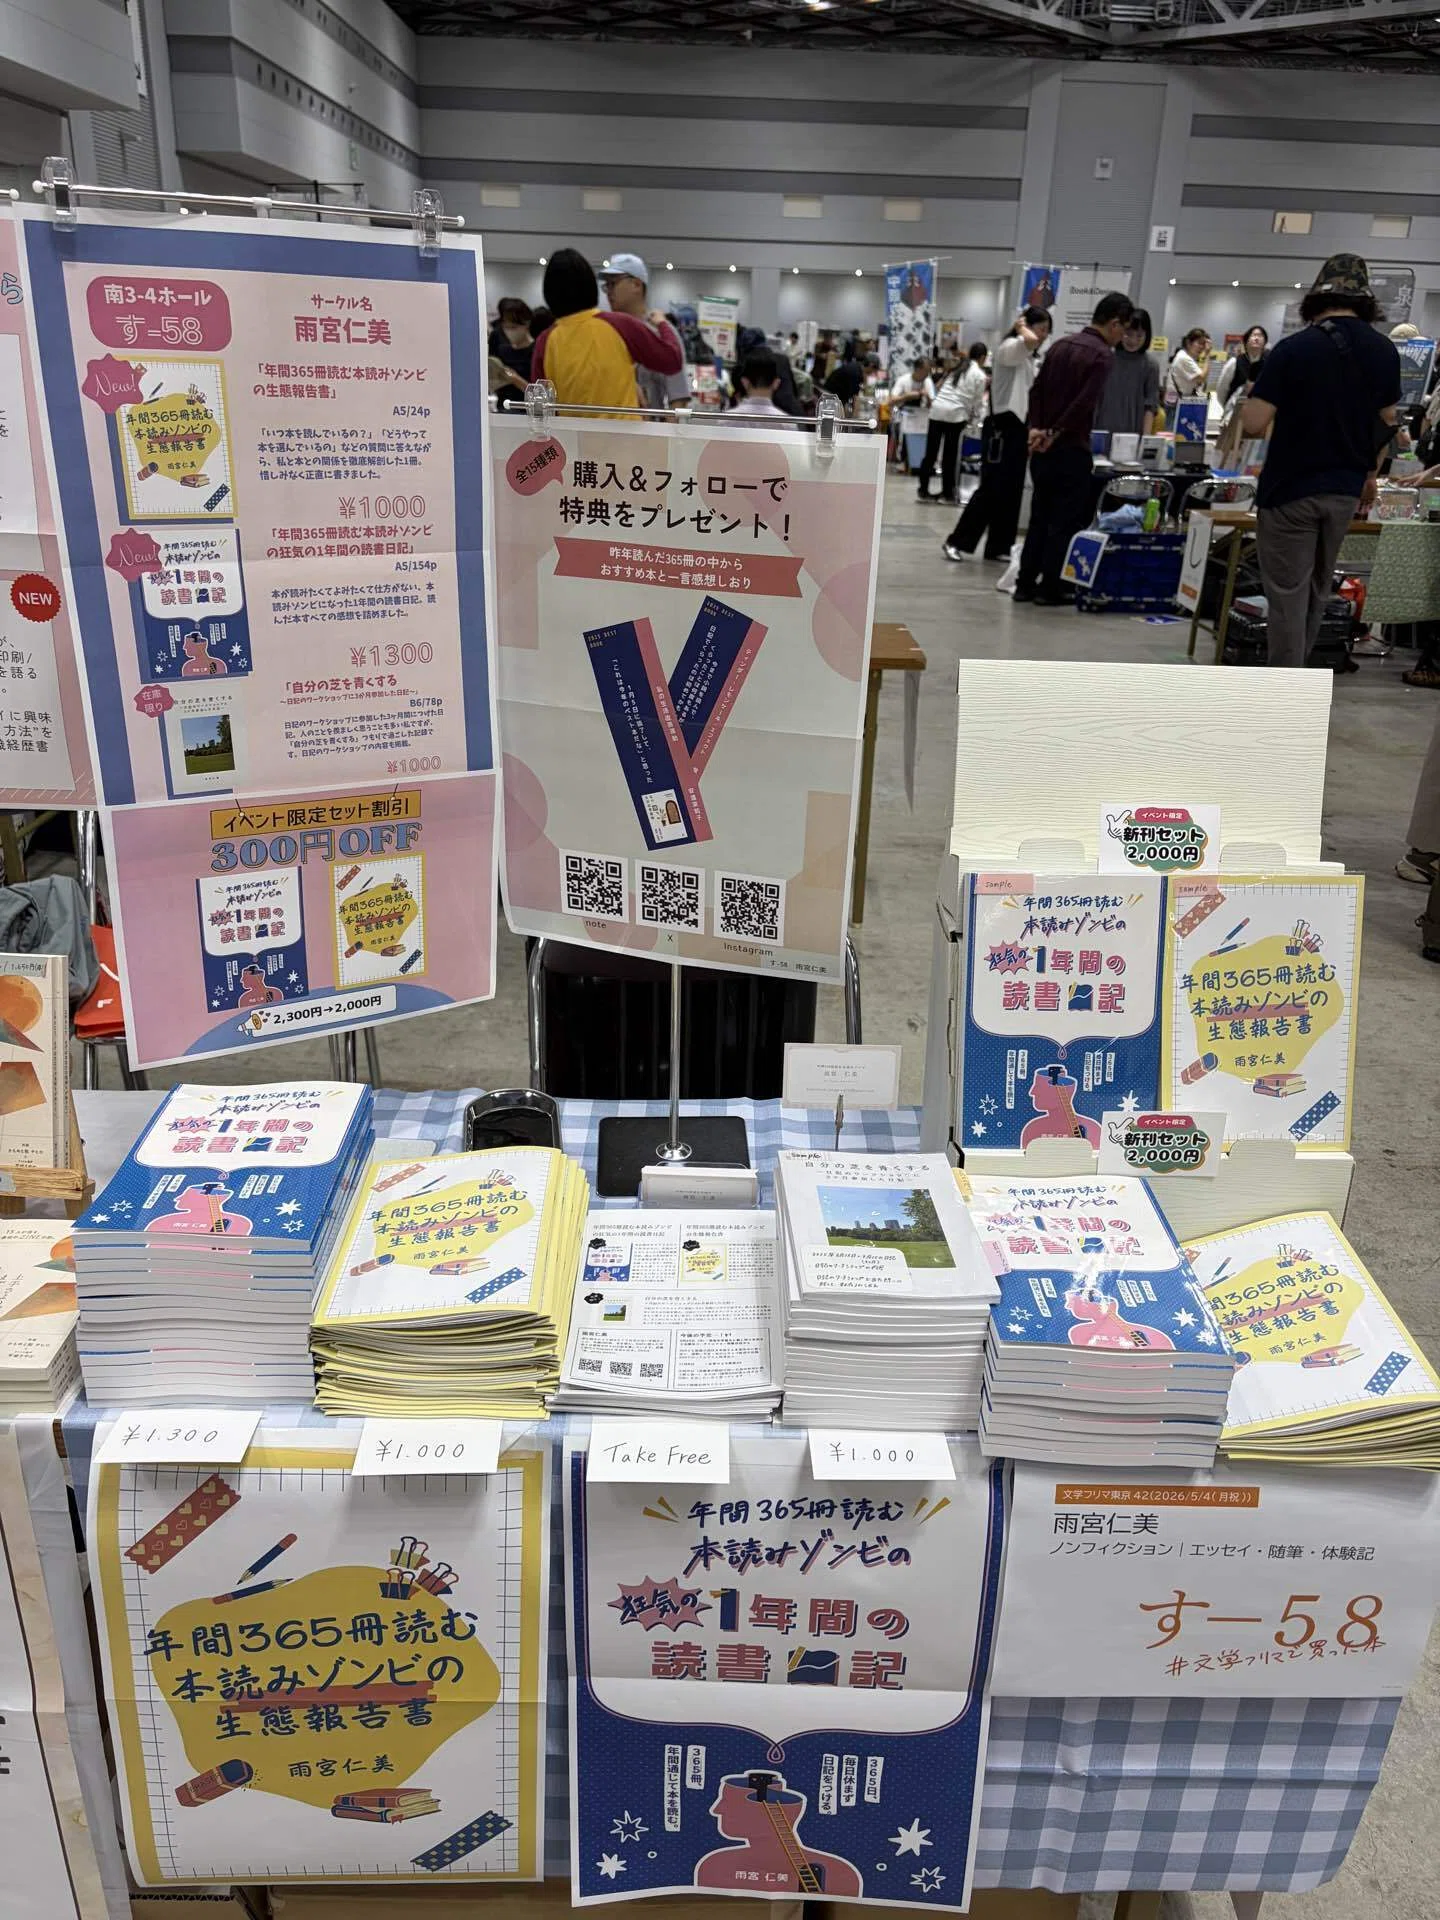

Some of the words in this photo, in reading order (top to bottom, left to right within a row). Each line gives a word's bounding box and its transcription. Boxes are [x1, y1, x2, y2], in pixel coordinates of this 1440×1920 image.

[104, 283, 212, 307] 南3-4ホール
[311, 294, 373, 312] サークル名
[293, 316, 392, 346] 雨宮仁美
[258, 363, 428, 382] 「年間365冊読む本読みゾンビ
[95, 374, 136, 397] New!
[253, 384, 337, 399] の生態報告書」
[392, 405, 431, 417] A5/24p
[260, 469, 382, 481] 惜しみなく正直に書きました。
[515, 446, 559, 485] 全15種類
[573, 460, 787, 502] 購入&フォローで
[339, 495, 426, 519] ¥1000
[271, 524, 433, 541] 「年間365冊読む本読みゾンビ
[119, 543, 158, 567] New!
[266, 542, 415, 559] の狂気の1年間の読書日記」
[610, 547, 744, 571] 昨年読んだ365冊の中から
[395, 560, 437, 573] A5/154p
[601, 564, 751, 590] おすすめ本と一言感想しおり
[18, 592, 53, 605] NEW
[350, 641, 433, 668] ¥1300
[285, 674, 398, 694] 「自分の芝を青くする
[409, 698, 443, 709] B6/78p
[387, 755, 442, 774] ¥1000
[223, 798, 410, 833] イベント限定セット割引
[1141, 811, 1183, 820] イベント限定
[1123, 826, 1204, 843] 新刊セット
[210, 822, 423, 872] 300円OFF
[1127, 846, 1199, 861] 2,000円
[1023, 895, 1124, 912] 年間365冊読む
[585, 919, 607, 929] note
[667, 934, 673, 942] X
[723, 943, 773, 957] Instagram
[1020, 912, 1126, 940] 本読みゾンビの
[1180, 963, 1336, 991] 年間365冊読む
[1190, 990, 1328, 1018] 本読みゾンビの
[1206, 1014, 1314, 1043] 生態報告書
[1234, 1052, 1286, 1066] 雨宮仁美
[1124, 1132, 1207, 1147] 新刊セット
[1127, 1149, 1200, 1163] 2,000円
[367, 1190, 528, 1222] 年間365冊読む
[374, 1205, 519, 1235] 本読みゾンビの
[388, 1220, 503, 1249] 生態報告書
[413, 1246, 469, 1261] 雨宮仁美
[1221, 1282, 1343, 1327] 読みゾンビの
[1229, 1301, 1339, 1345] 生態報告書
[1270, 1332, 1326, 1356] 雨宮仁美
[604, 1442, 658, 1466] Take
[667, 1446, 711, 1466] Free
[687, 1497, 904, 1530] 年間365冊読む
[1054, 1513, 1159, 1534] 雨宮仁美
[682, 1527, 911, 1578] 本読みゾンビの
[620, 1588, 698, 1625] 狂気の
[144, 1608, 478, 1662] 年間365冊読む
[172, 1653, 464, 1703] 本読みゾンビの
[215, 1696, 435, 1741] 生態報告書
[287, 1754, 396, 1779] 雨宮仁美
[667, 1746, 680, 1830] 年間通じて本を読む。
[821, 1755, 835, 1814] 日記をつける。
[845, 1757, 857, 1805] 毎日休まず
